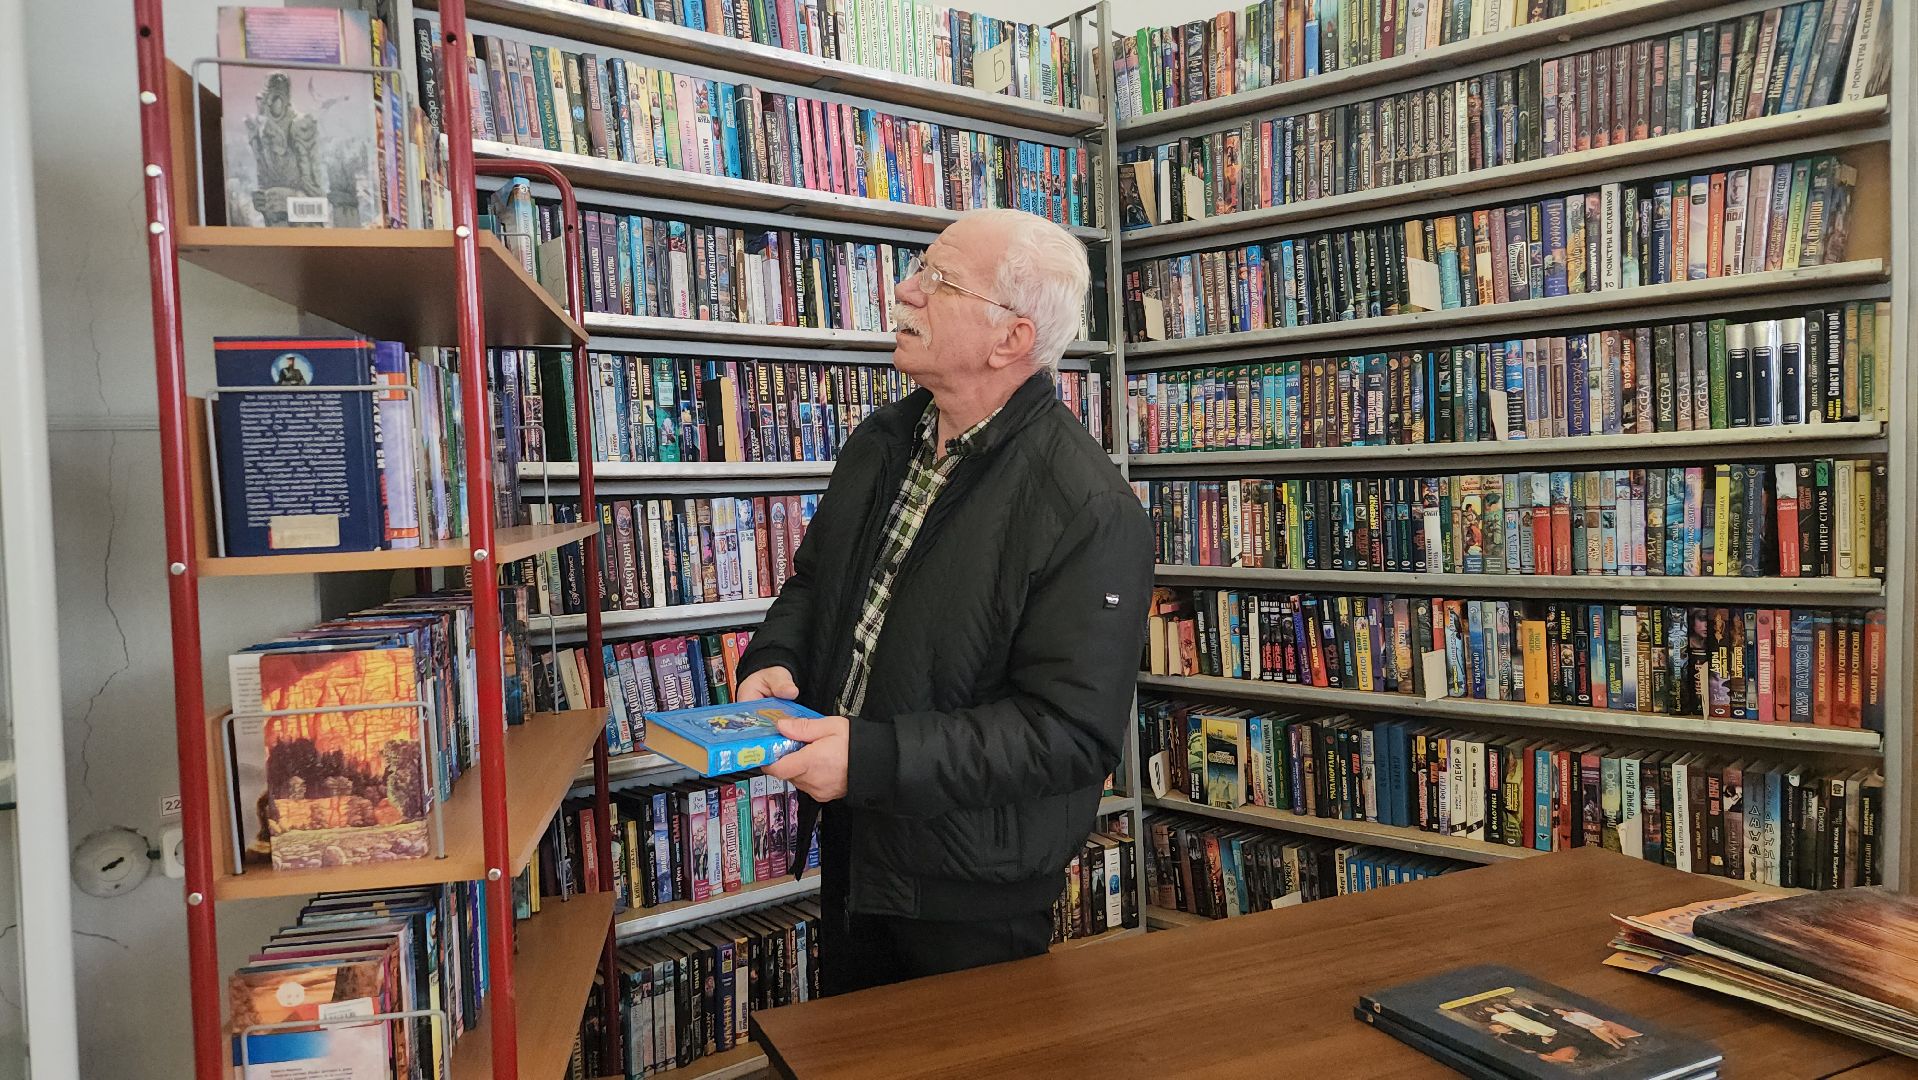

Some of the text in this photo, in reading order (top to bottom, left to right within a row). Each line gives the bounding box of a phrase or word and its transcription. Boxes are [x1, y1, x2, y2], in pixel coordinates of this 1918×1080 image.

[707, 235, 718, 300] ПЕРЕСМЕШНИКИ
[1623, 340, 1632, 389] ВТОРЖЕНИЕ
[1826, 313, 1840, 396] Спасти Императора!
[1571, 398, 1585, 431] фэнтези
[1639, 386, 1650, 422] РАССЕЛ
[1661, 383, 1672, 422] РАССЕЛ
[1679, 383, 1690, 420] РАССЕЛ
[1696, 382, 1707, 419] РАССЕЛ
[1818, 490, 1829, 552] ПИТЕР СТРАУБ
[682, 552, 691, 576] ДИВЕР
[1647, 534, 1657, 561] МАГ
[1710, 652, 1720, 673] Дары
[1818, 630, 1826, 702] МИХАИЛ УСПЕНСКИЙ
[1837, 630, 1846, 702] МИХАИЛ УСПЕНСКИЙ
[1851, 632, 1860, 674] УСПЕНСКИЙ
[1870, 632, 1879, 704] МИХАИЛ УСПЕНСКИЙ
[1794, 644, 1808, 715] МИР ПАУКОВ
[1327, 750, 1335, 782] МОРГАНА
[1454, 758, 1463, 782] ДЕЙР
[1624, 763, 1635, 820] ГОРЯЧИЕ ДЕНЬГИ
[672, 815, 680, 842] ТЬМЫ
[725, 823, 738, 855] КАМША
